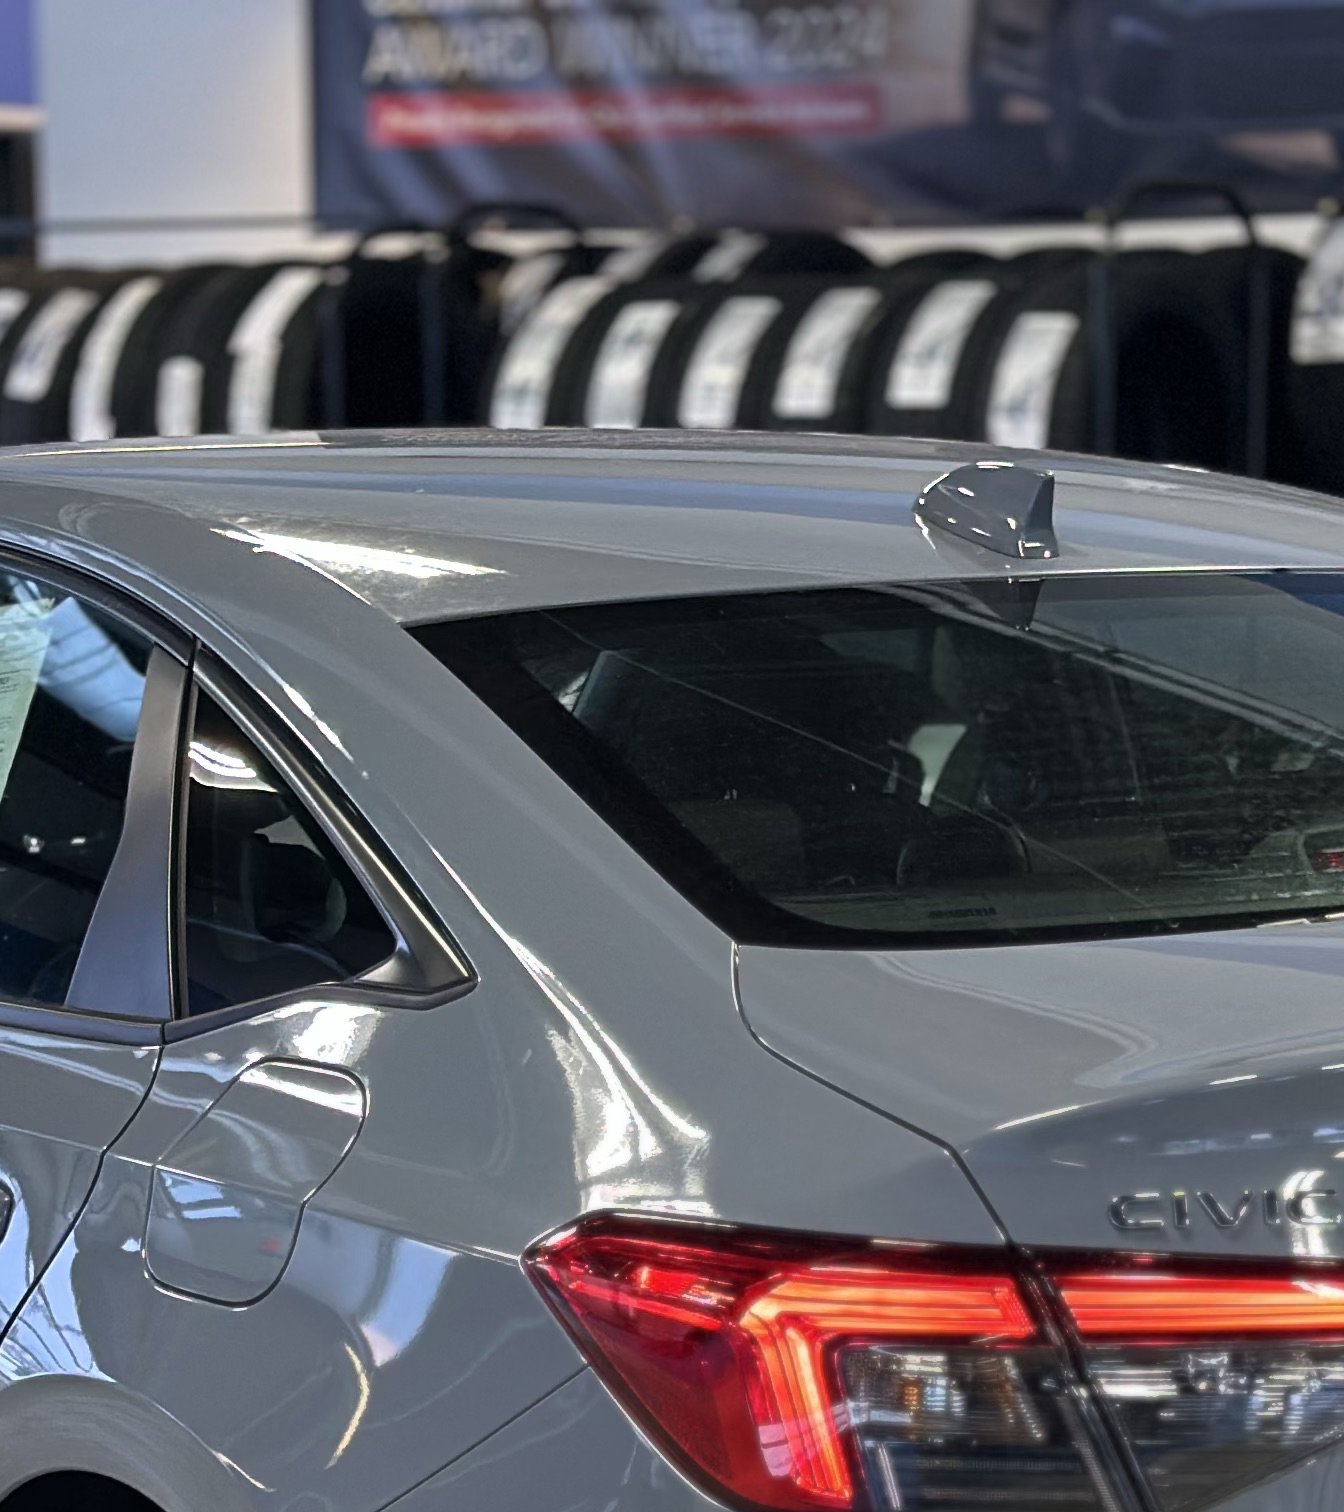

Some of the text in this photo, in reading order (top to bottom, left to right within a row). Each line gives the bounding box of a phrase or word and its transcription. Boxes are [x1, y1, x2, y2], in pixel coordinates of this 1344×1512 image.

[361, 16, 549, 83] AWARD
[555, 10, 759, 76] WINNER
[1108, 1189, 1343, 1230] CIVIC
